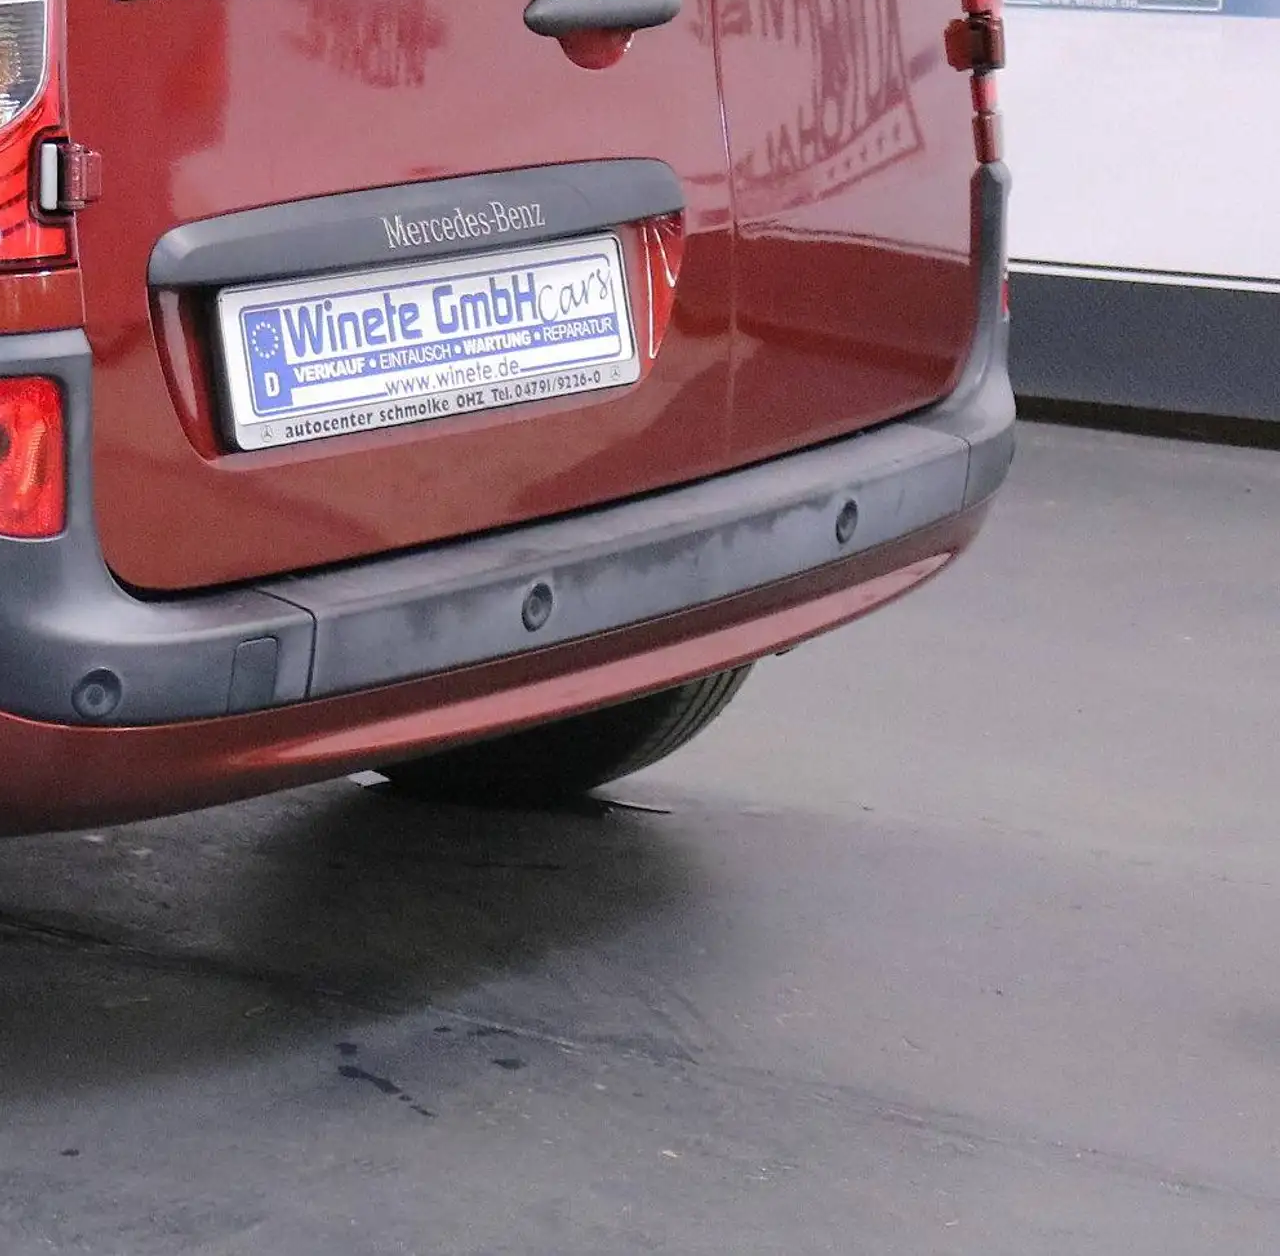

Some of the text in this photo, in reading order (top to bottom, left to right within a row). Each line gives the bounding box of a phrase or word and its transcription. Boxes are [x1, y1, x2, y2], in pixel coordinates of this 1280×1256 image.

[380, 200, 546, 249] Mercedes-Benz
[431, 271, 538, 335] GmbH
[292, 316, 613, 384] VERKAUF EINTAUSCH WARTUNG REPARATUR
[264, 371, 280, 397] D
[384, 355, 521, 397] www.winete.de
[285, 409, 374, 439] autocenter
[378, 397, 450, 424] schmolke
[456, 390, 486, 408] OHZ
[491, 387, 513, 402] Tel.
